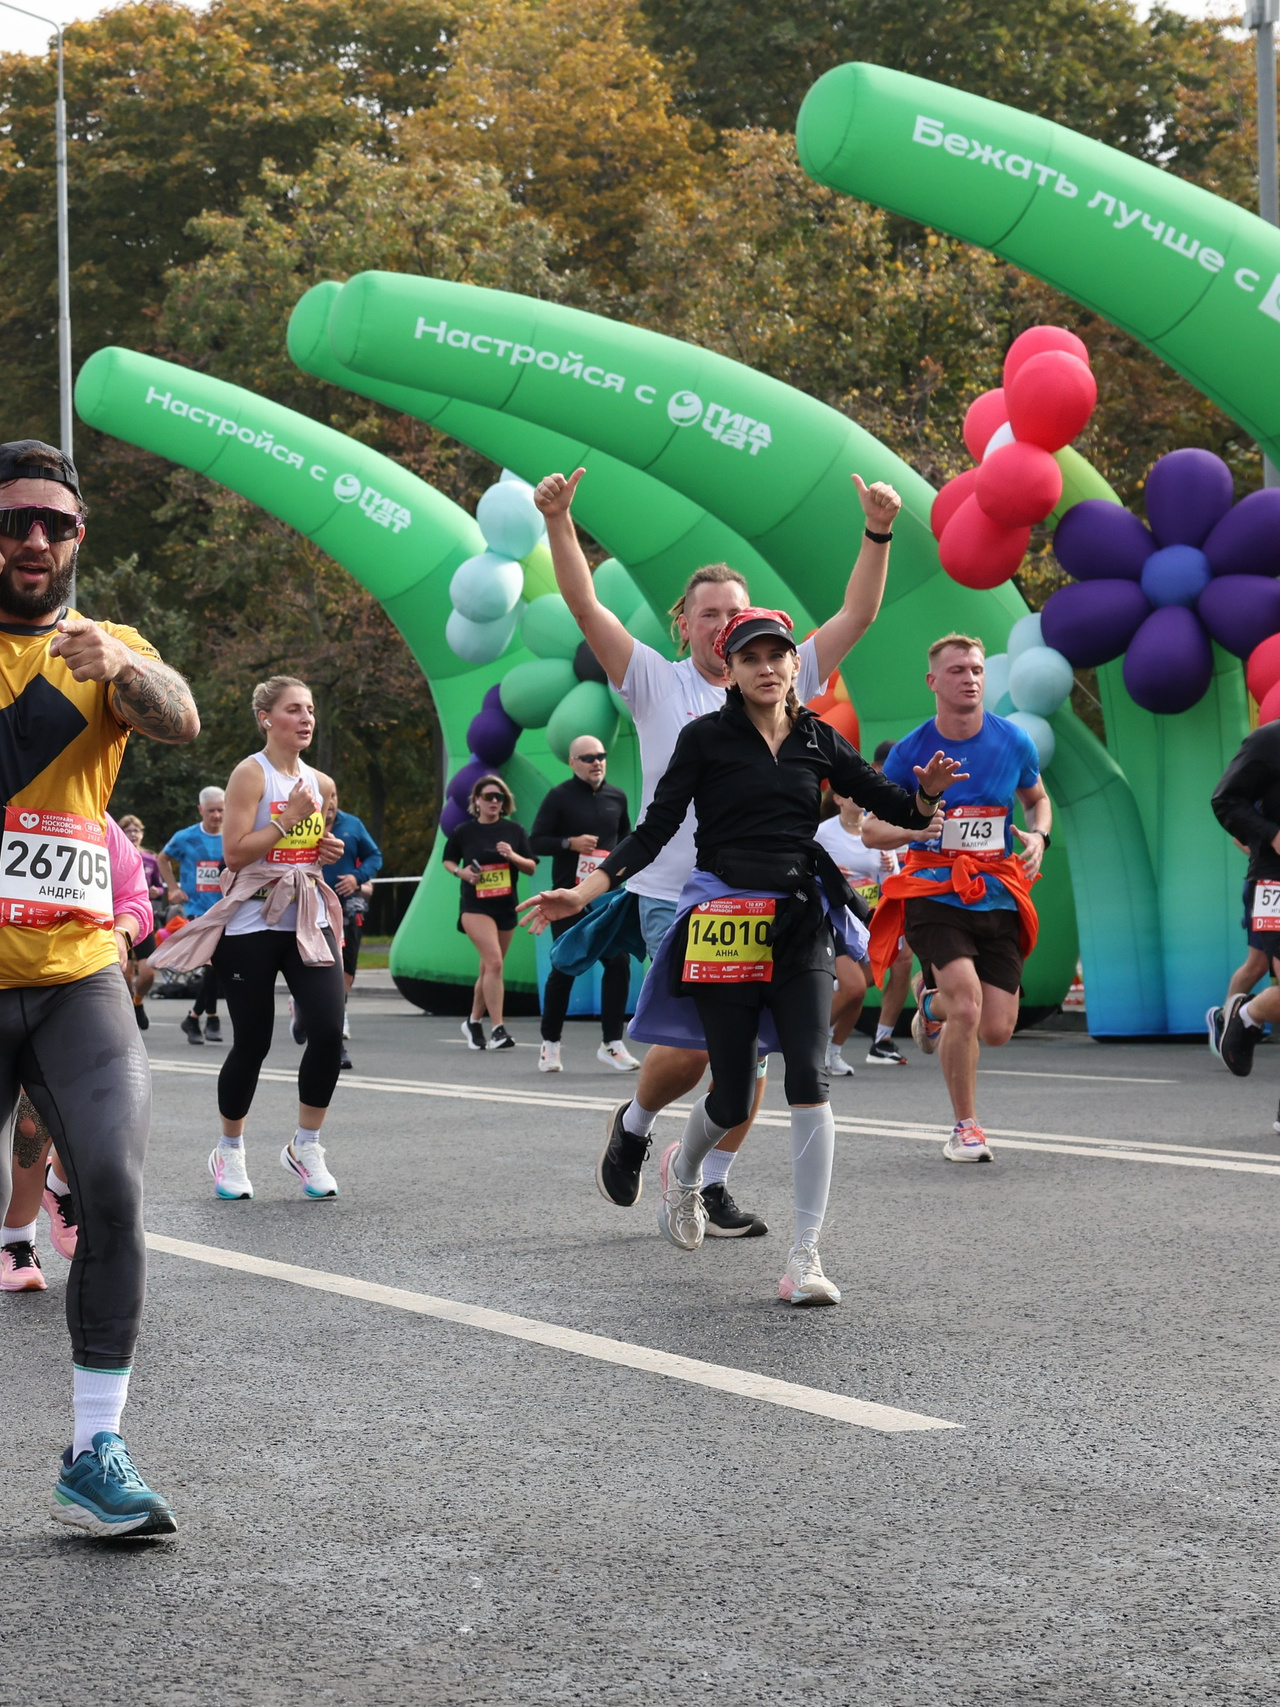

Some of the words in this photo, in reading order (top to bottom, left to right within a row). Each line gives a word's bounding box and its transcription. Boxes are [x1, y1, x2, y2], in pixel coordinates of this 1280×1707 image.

[912, 114, 1078, 199] Бежать
[1087, 190, 1225, 273] лучше
[1234, 267, 1260, 292] с
[414, 316, 625, 393] Настройся
[634, 384, 657, 404] с
[706, 402, 772, 443] ГИГА
[145, 386, 305, 469] Настройся
[310, 464, 328, 481] с
[361, 486, 411, 525] ГИГА
[43, 815, 74, 823] СБЕРПРАЙМ
[41, 826, 74, 835] МАРАФОН
[960, 821, 992, 840] 743
[961, 840, 989, 848] ВАЛЕРИЙ
[273, 850, 281, 862] E
[4, 840, 108, 890] 26705
[580, 861, 597, 873] 28
[480, 872, 504, 884] 6451
[38, 885, 86, 900] АНДРЕЙ
[10, 903, 25, 923] E
[692, 920, 771, 947] 14010
[715, 949, 739, 957] АННА
[690, 963, 699, 979] E
